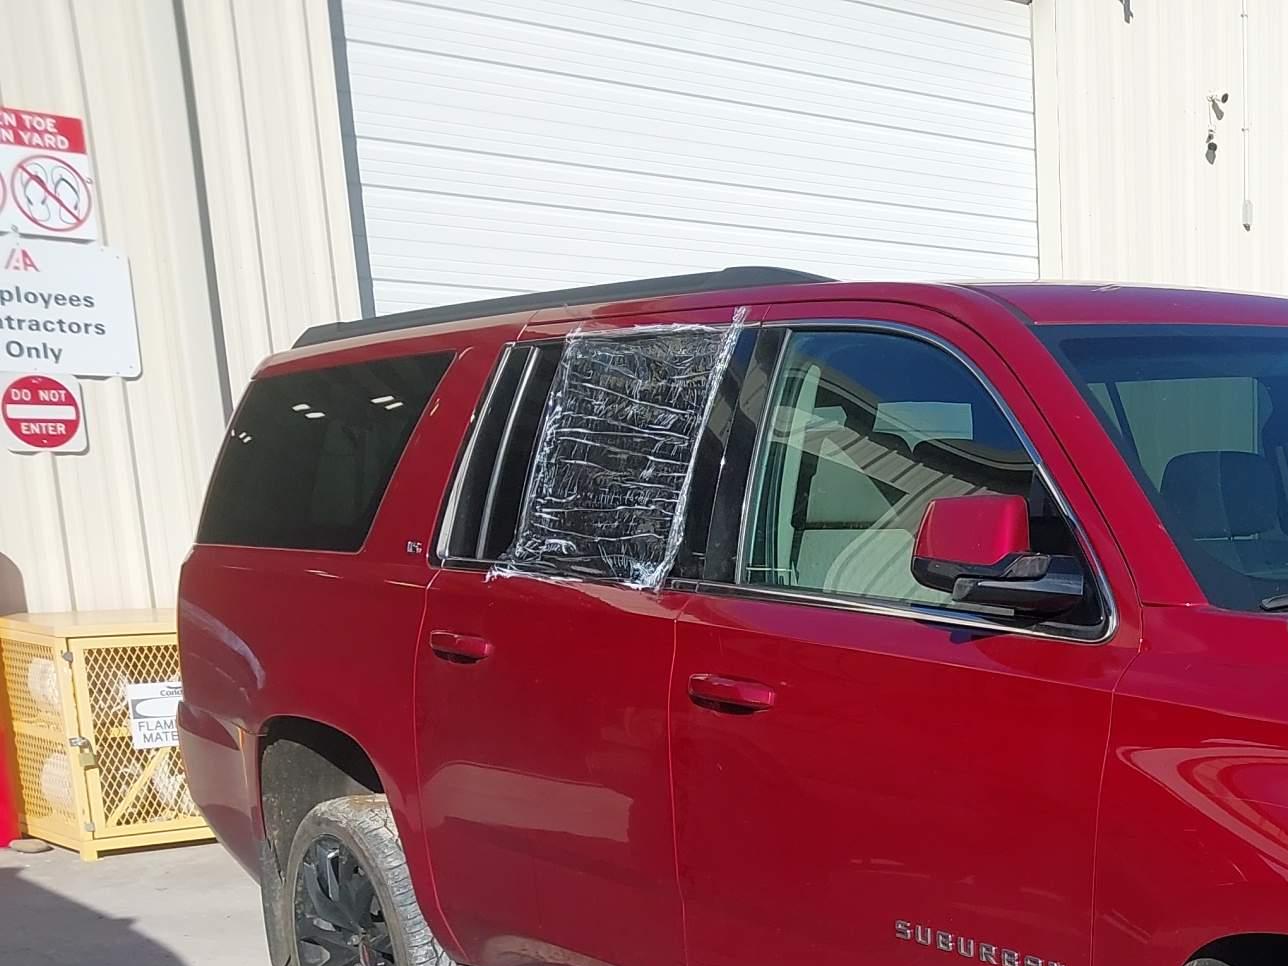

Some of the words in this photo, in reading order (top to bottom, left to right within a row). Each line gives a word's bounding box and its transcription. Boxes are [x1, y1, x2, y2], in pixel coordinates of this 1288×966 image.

[21, 113, 58, 133] TOE
[18, 130, 70, 150] YARD
[6, 340, 62, 364] Only
[11, 388, 32, 401] DO
[38, 389, 67, 402] NOT
[21, 422, 67, 436] ENTER
[138, 719, 177, 731] FLAM
